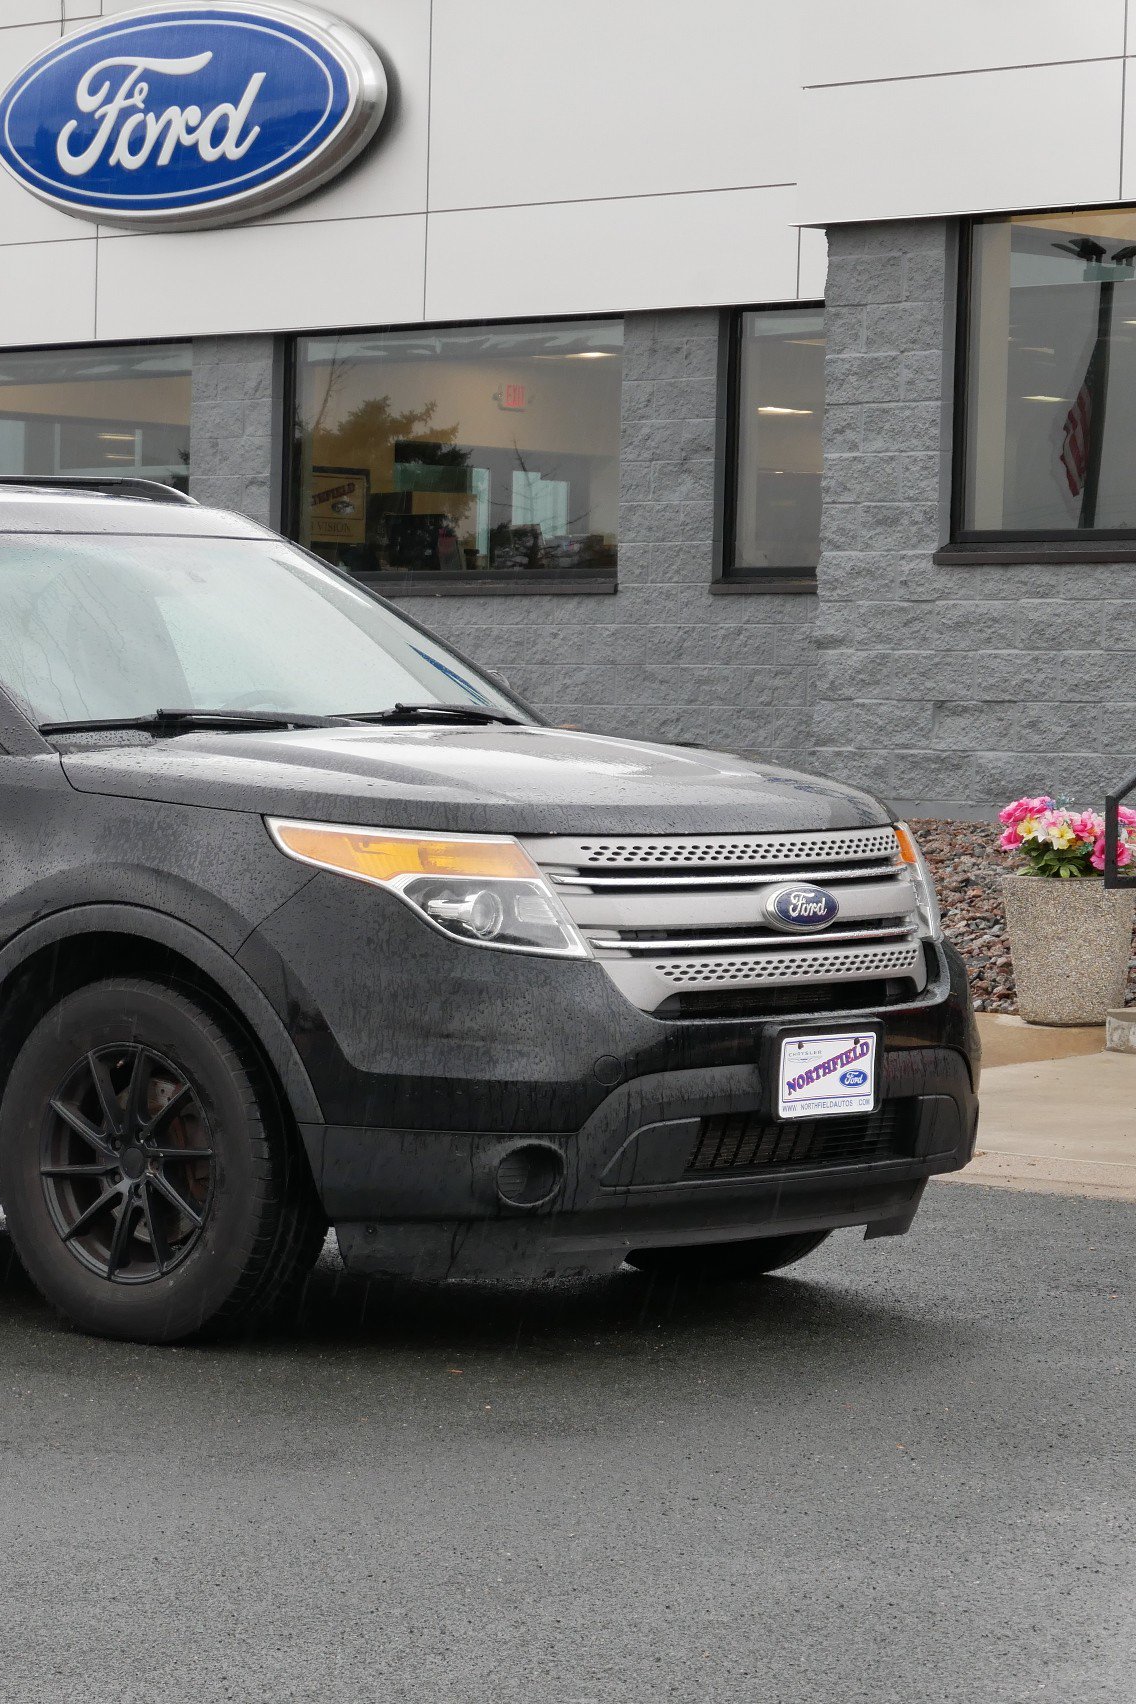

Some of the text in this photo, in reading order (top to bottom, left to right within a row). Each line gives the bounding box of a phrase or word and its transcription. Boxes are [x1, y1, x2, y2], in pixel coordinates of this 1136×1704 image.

[56, 50, 267, 177] Ford
[505, 384, 526, 407] EXIT
[789, 891, 828, 918] Ford
[786, 1041, 870, 1096] NORTHFIELD
[844, 1072, 863, 1085] Ford
